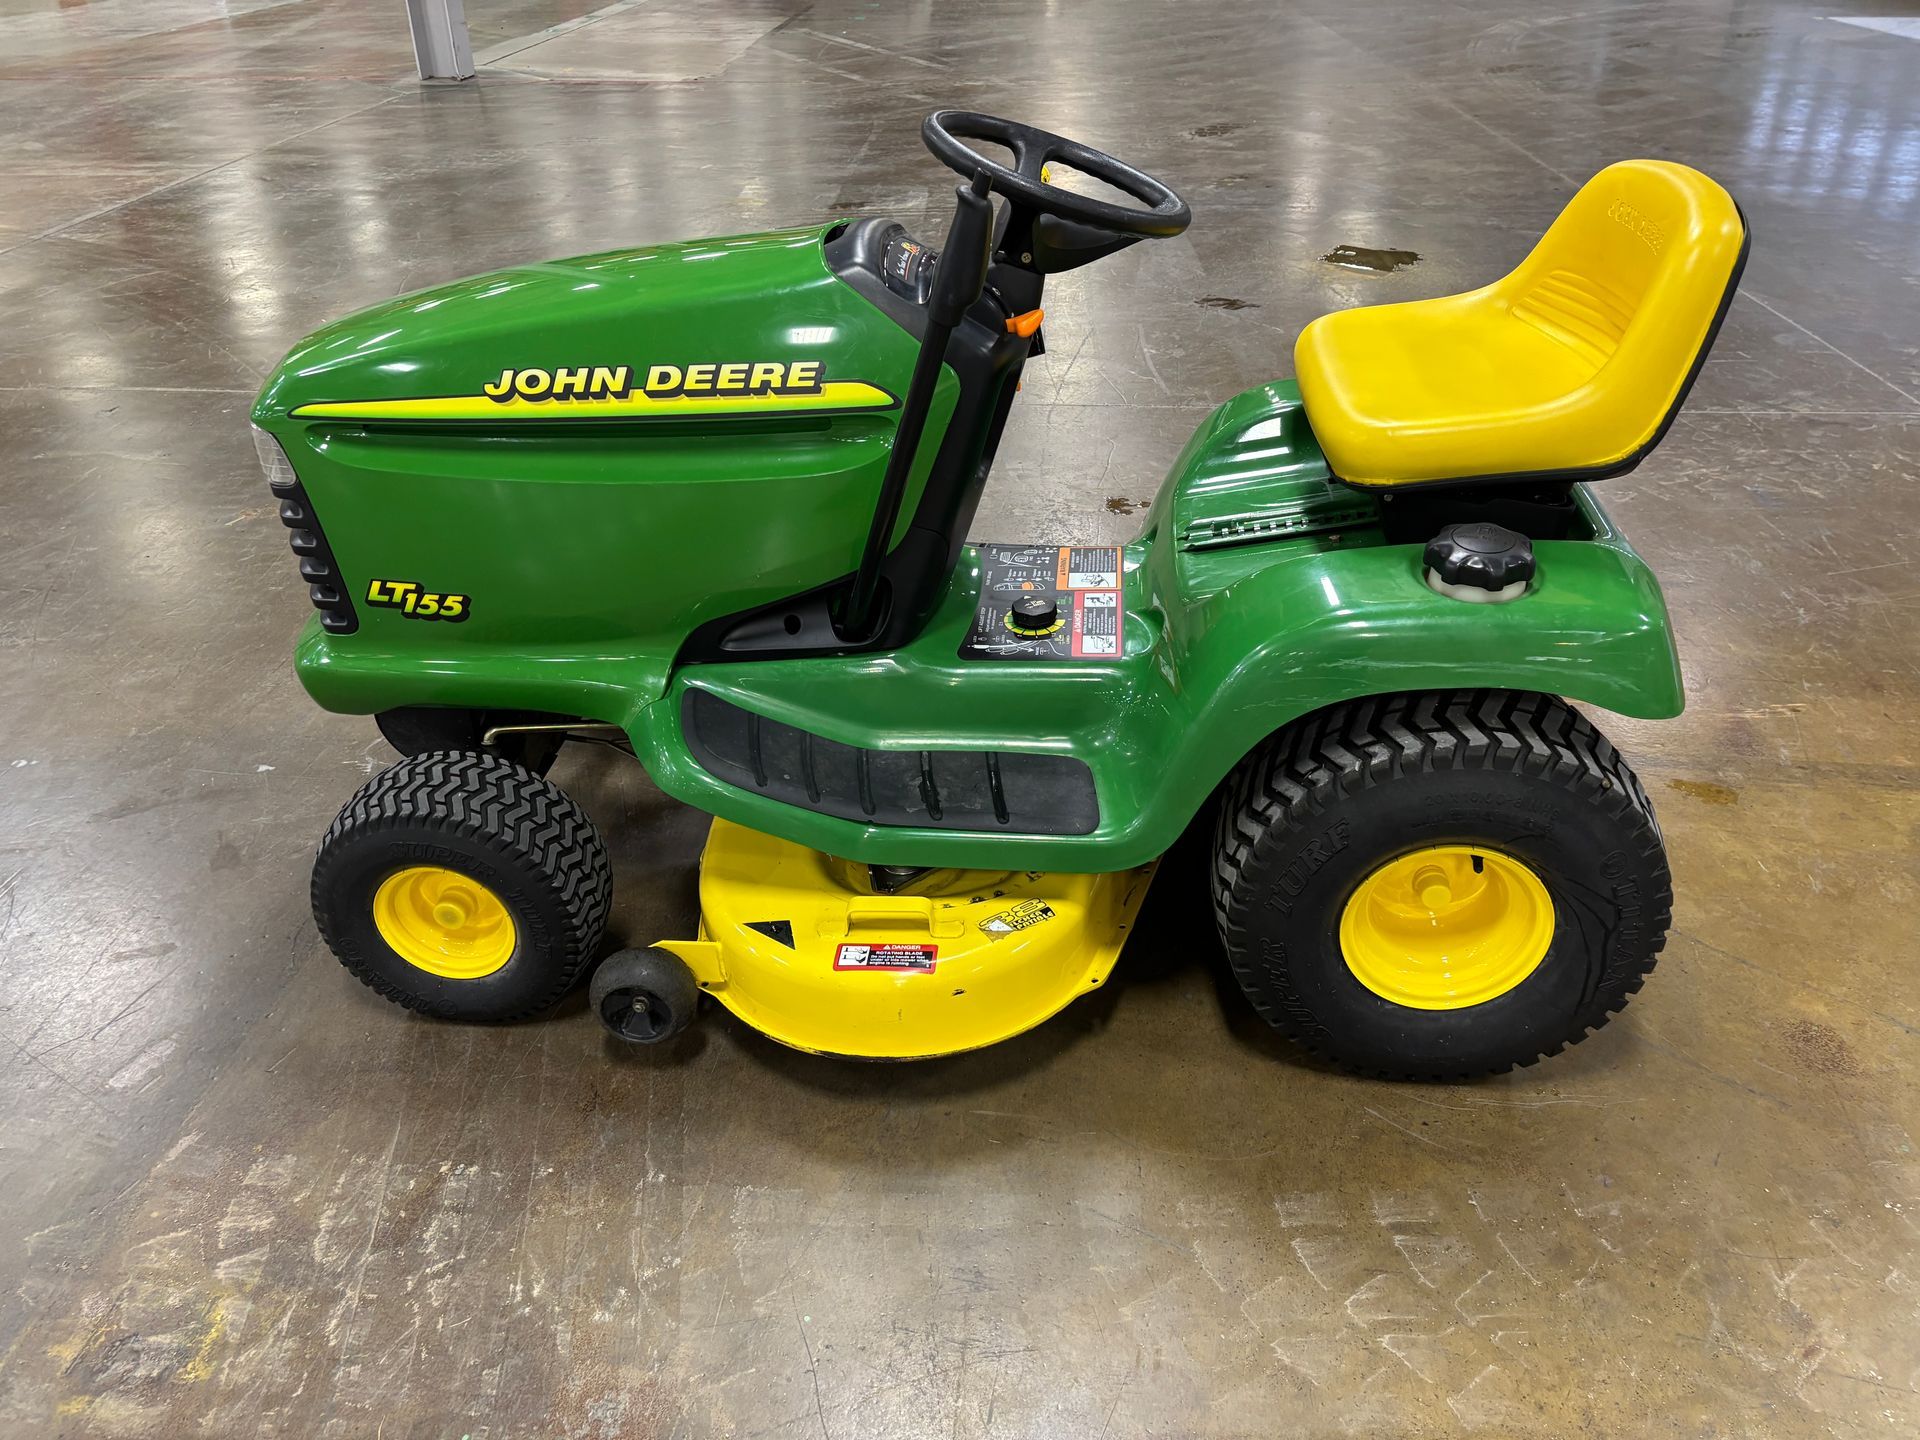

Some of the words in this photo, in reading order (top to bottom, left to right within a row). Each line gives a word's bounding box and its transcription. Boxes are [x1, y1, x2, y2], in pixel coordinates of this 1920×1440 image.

[484, 366, 633, 400] JOHN
[645, 362, 824, 398] DEERE
[366, 580, 469, 620] LT155
[1266, 817, 1350, 915] TURF
[1260, 936, 1334, 1039] SUPER
